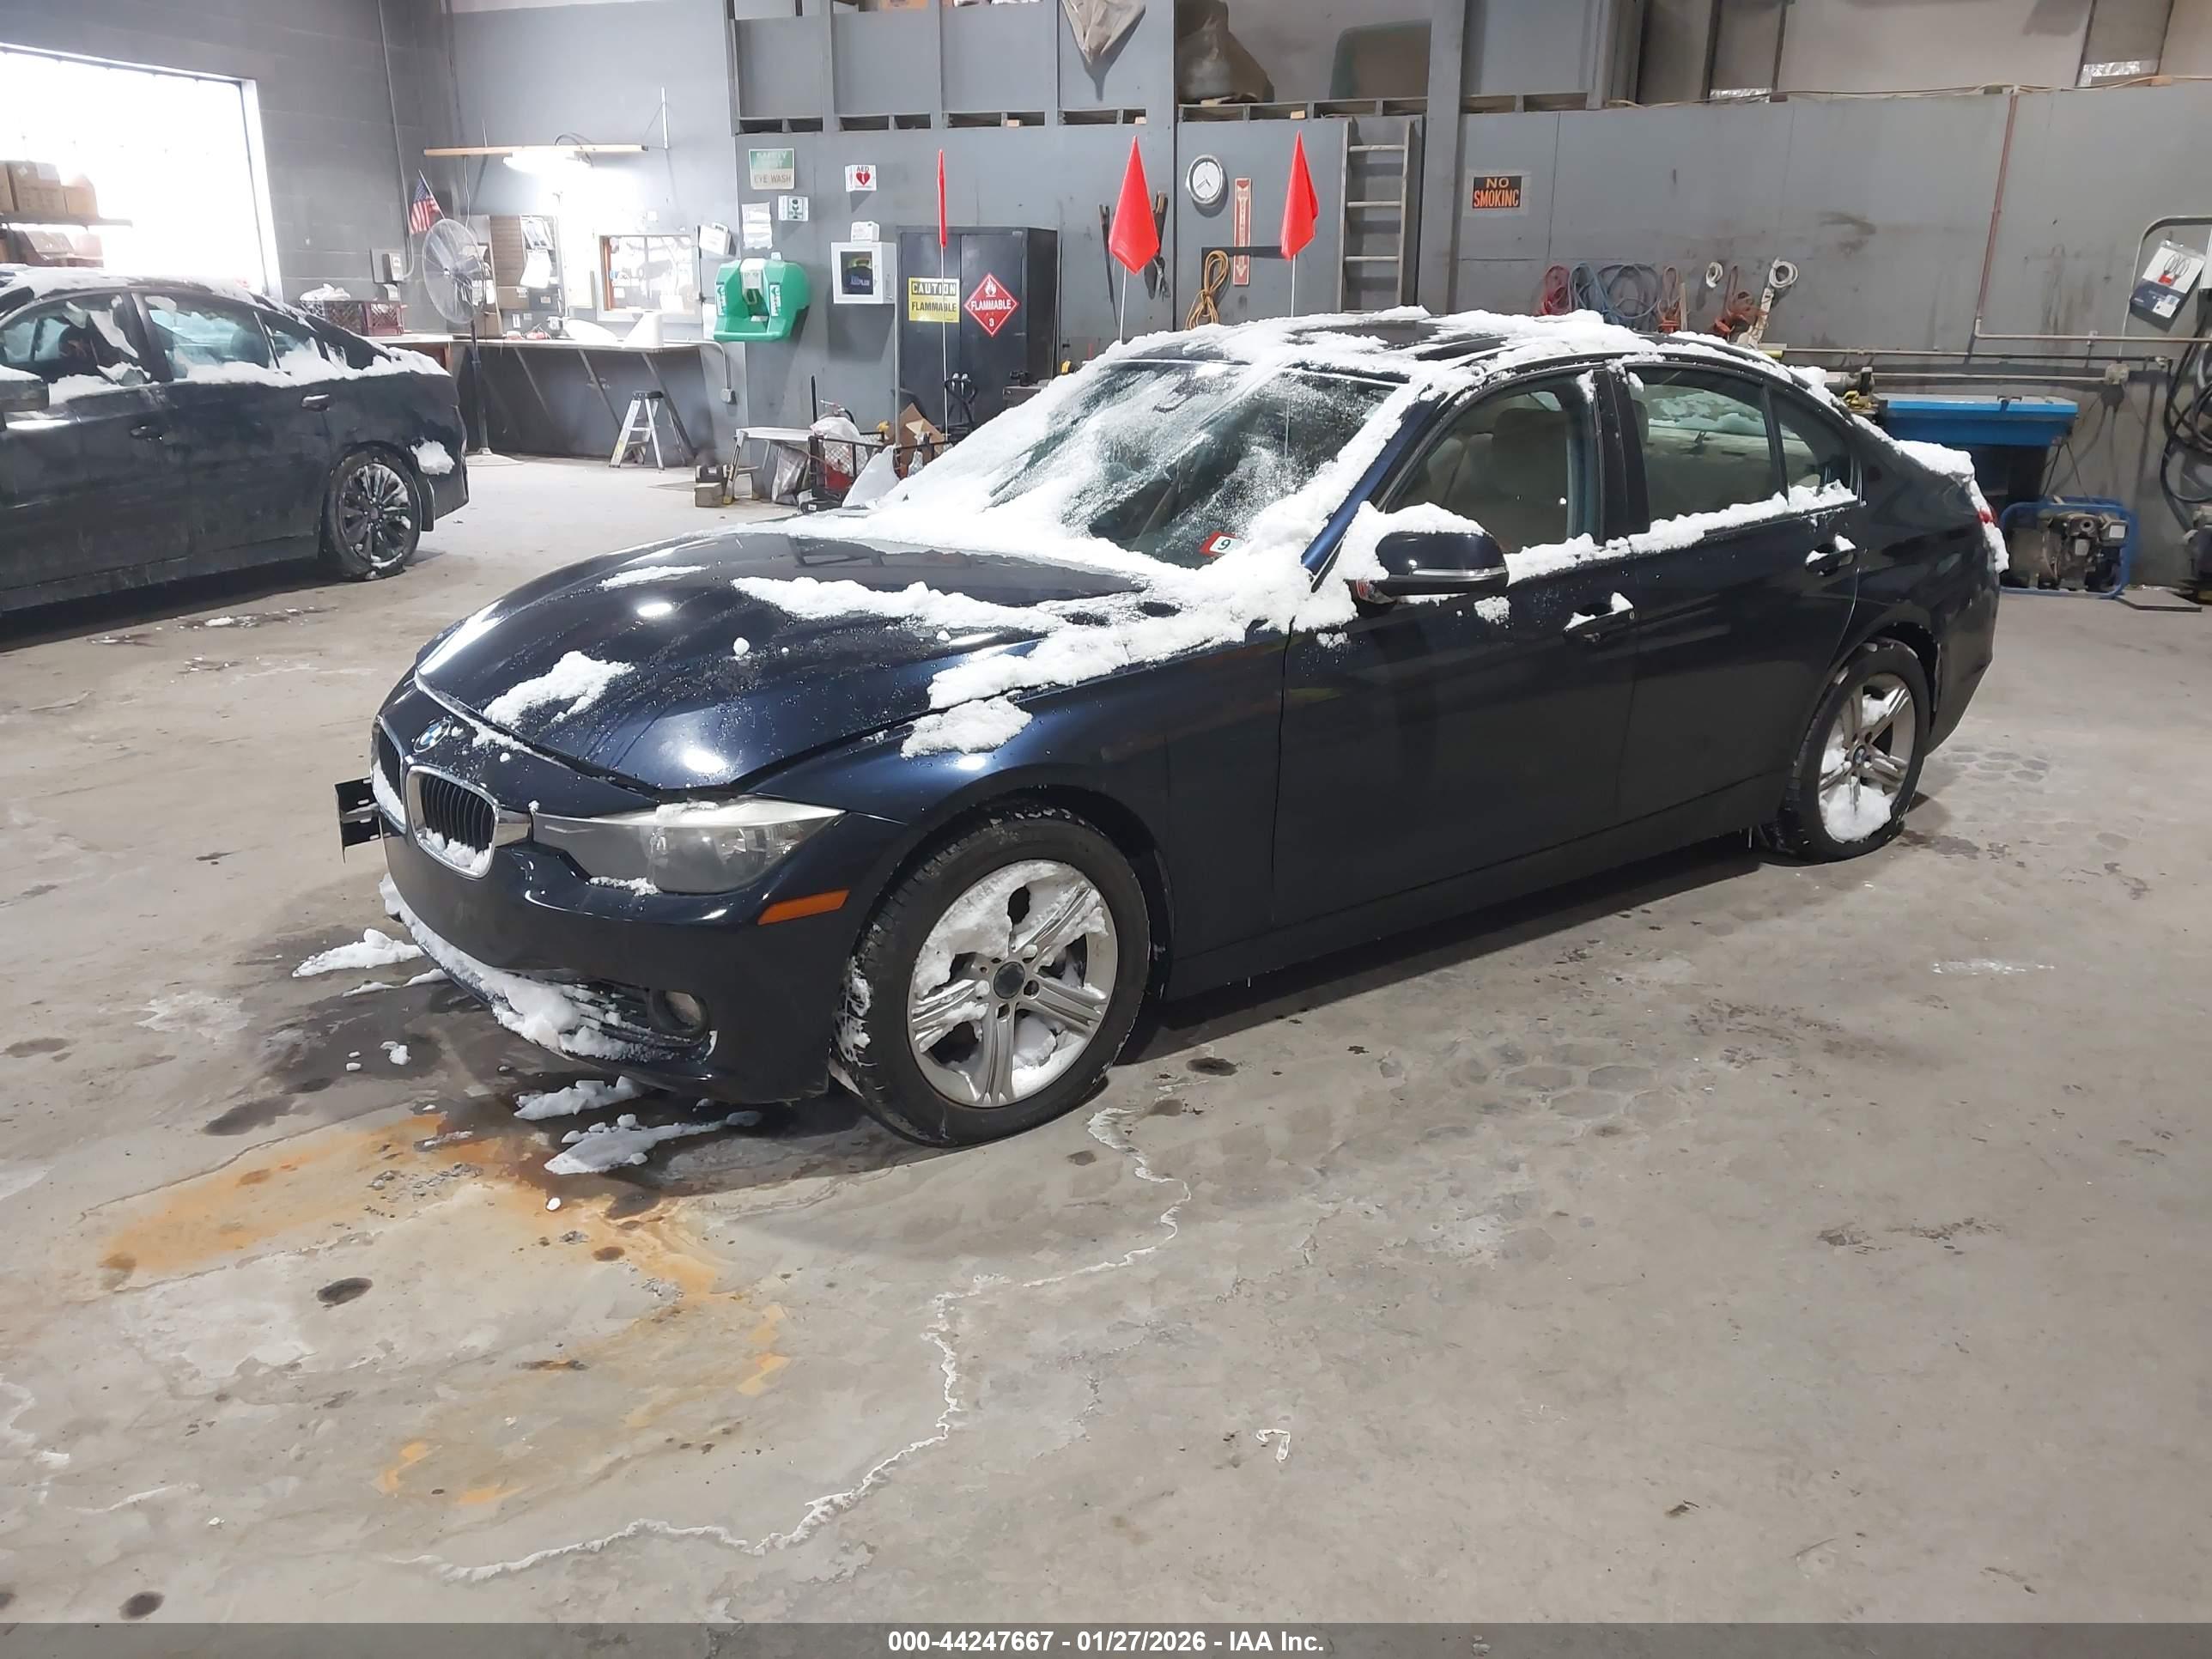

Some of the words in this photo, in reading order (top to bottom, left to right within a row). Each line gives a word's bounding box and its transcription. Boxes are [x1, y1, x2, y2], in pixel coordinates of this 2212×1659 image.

[770, 173, 791, 183] WASH
[1486, 178, 1509, 188] NO
[912, 283, 956, 295] CAUTION
[911, 301, 957, 312] FLAMMABLE
[970, 299, 1012, 311] FLAMMABLE
[1217, 538, 1231, 550] 9
